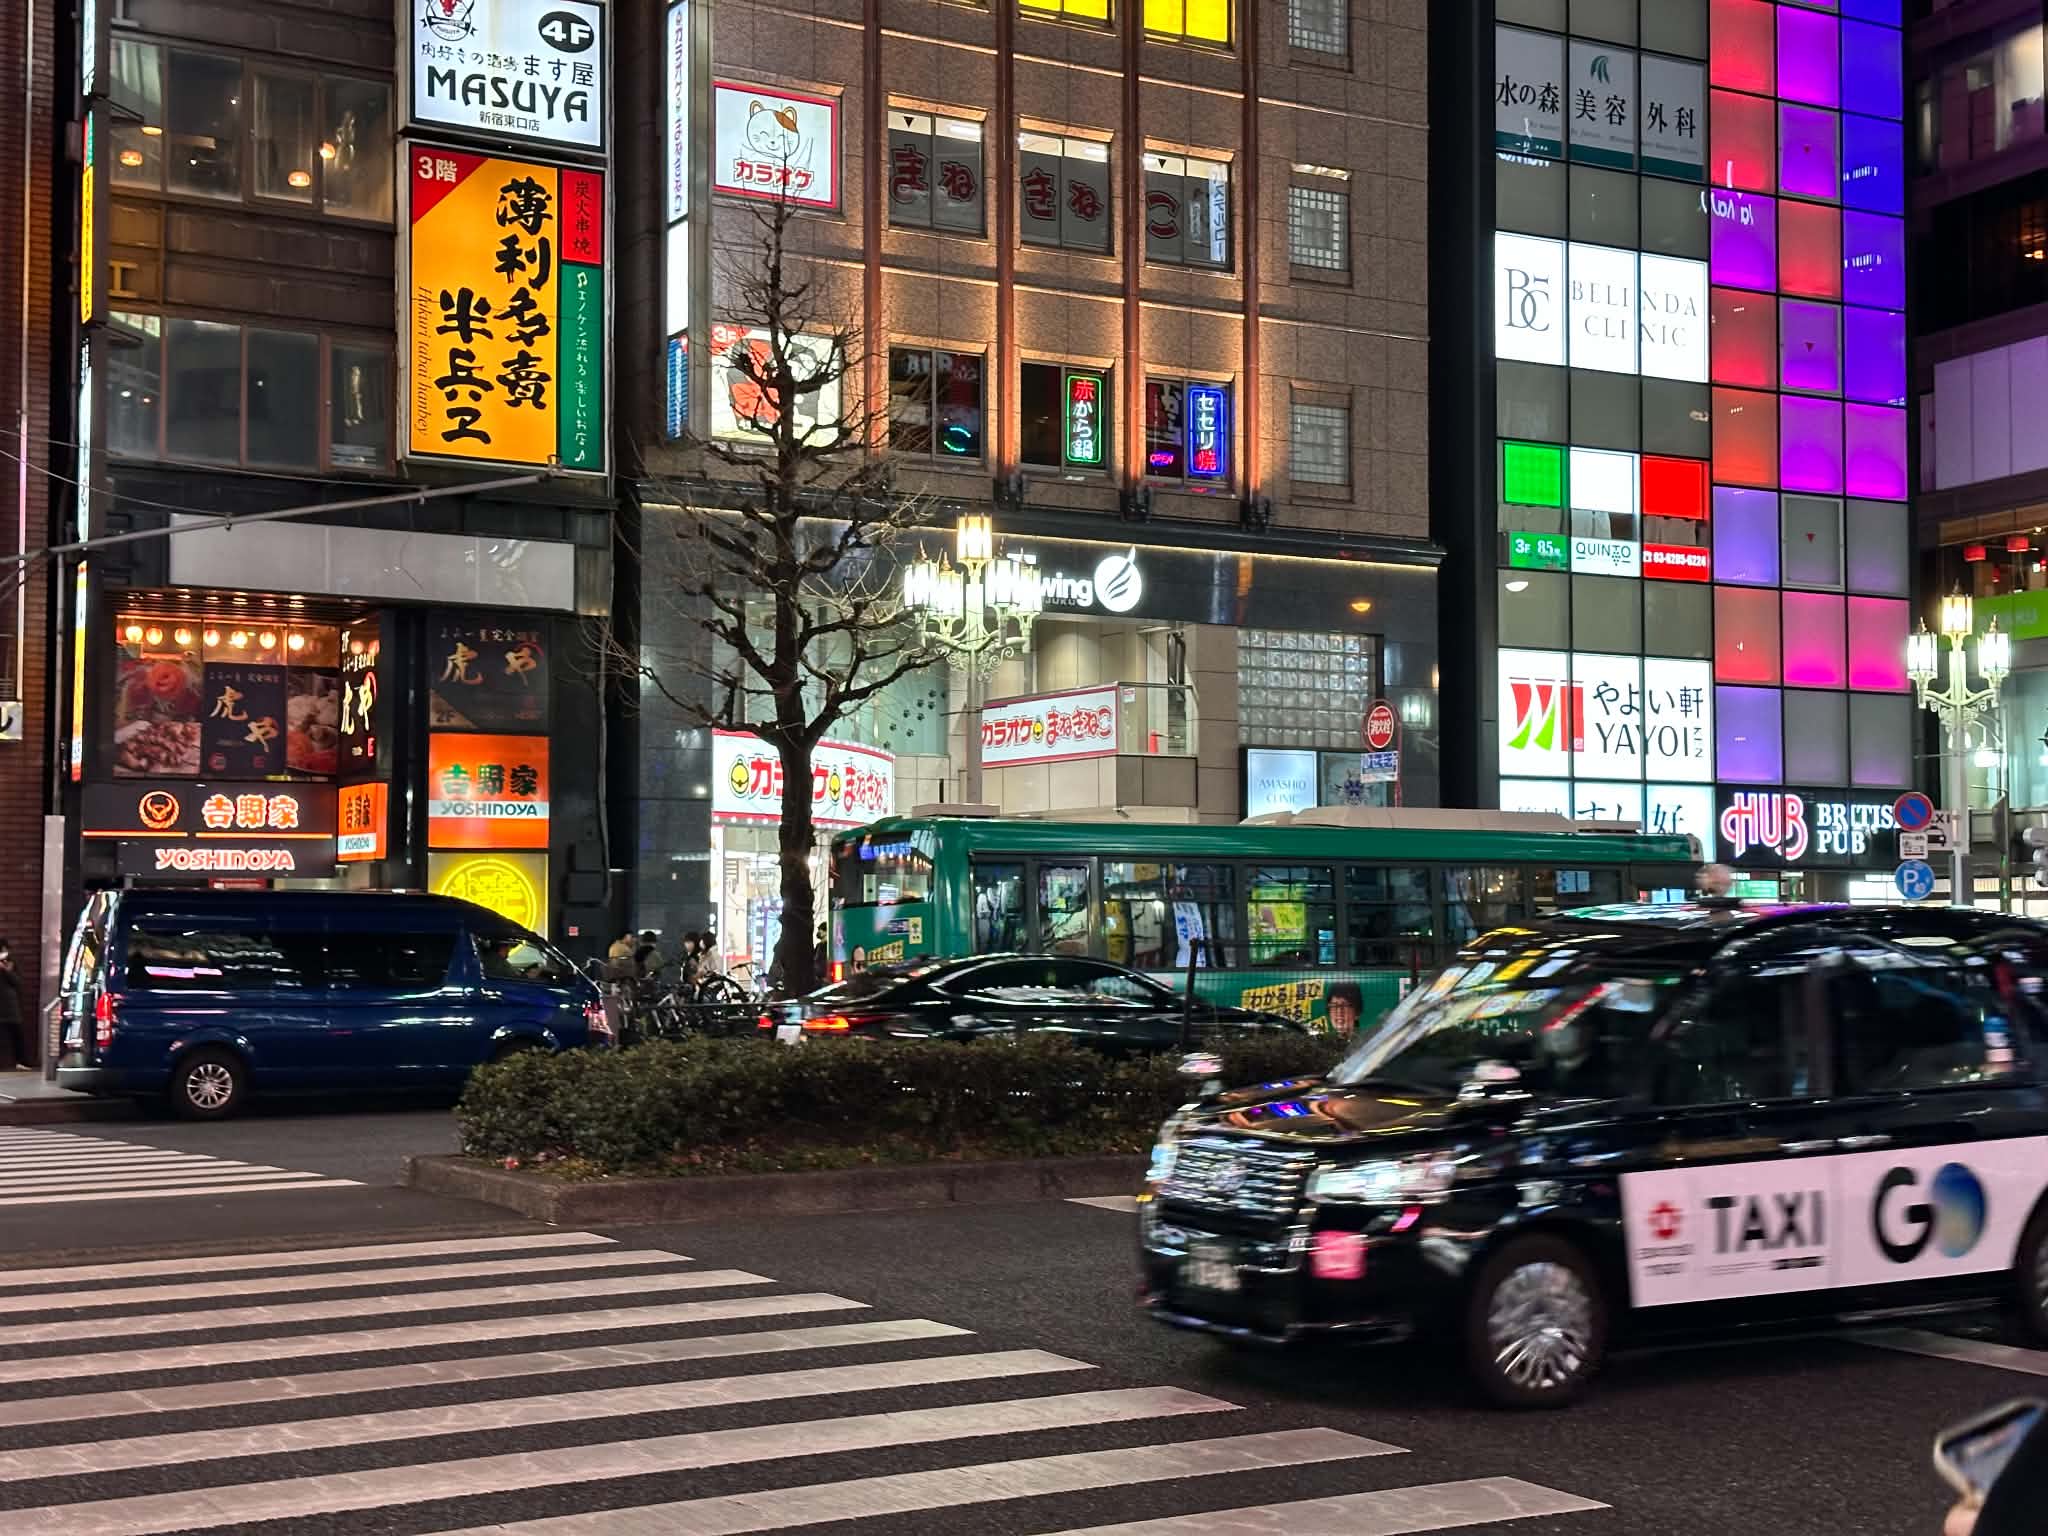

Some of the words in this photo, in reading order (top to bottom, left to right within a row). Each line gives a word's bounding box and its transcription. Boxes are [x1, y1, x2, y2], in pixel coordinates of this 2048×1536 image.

[541, 19, 591, 45] 4F
[524, 54, 595, 87] ます屋
[427, 65, 589, 124] MASUYA
[1495, 75, 1697, 138] 水の森美容外科
[479, 110, 541, 132] 新宿東口店
[417, 156, 458, 183] 3階
[734, 158, 814, 191] カラオケ
[1570, 279, 1698, 318] BELINDA
[712, 325, 737, 344] 3F
[1584, 315, 1688, 348] CLINIC
[1071, 379, 1096, 460] 赤から鍋
[1196, 391, 1217, 471] セセリ焼
[1149, 454, 1174, 465] OPEN
[1515, 538, 1531, 553] 3F
[1575, 542, 1632, 561] QUINTO
[1593, 680, 1704, 718] やよい軒
[982, 717, 1033, 748] カラオケ
[1044, 705, 1113, 748] まねきねこ
[1595, 722, 1689, 757] YAYOI
[441, 763, 539, 797] 吉野家
[843, 764, 890, 815] まねきねこ
[202, 793, 300, 829] 吉野家
[441, 803, 539, 816] YOSHINOYA
[1816, 803, 1900, 832] BRITIS
[1721, 792, 1809, 861] HUB
[1816, 829, 1867, 855] PUB
[155, 848, 296, 871] YOSHINOYA
[1704, 1190, 1825, 1254] TAXI
[1874, 1160, 1988, 1265] GO
